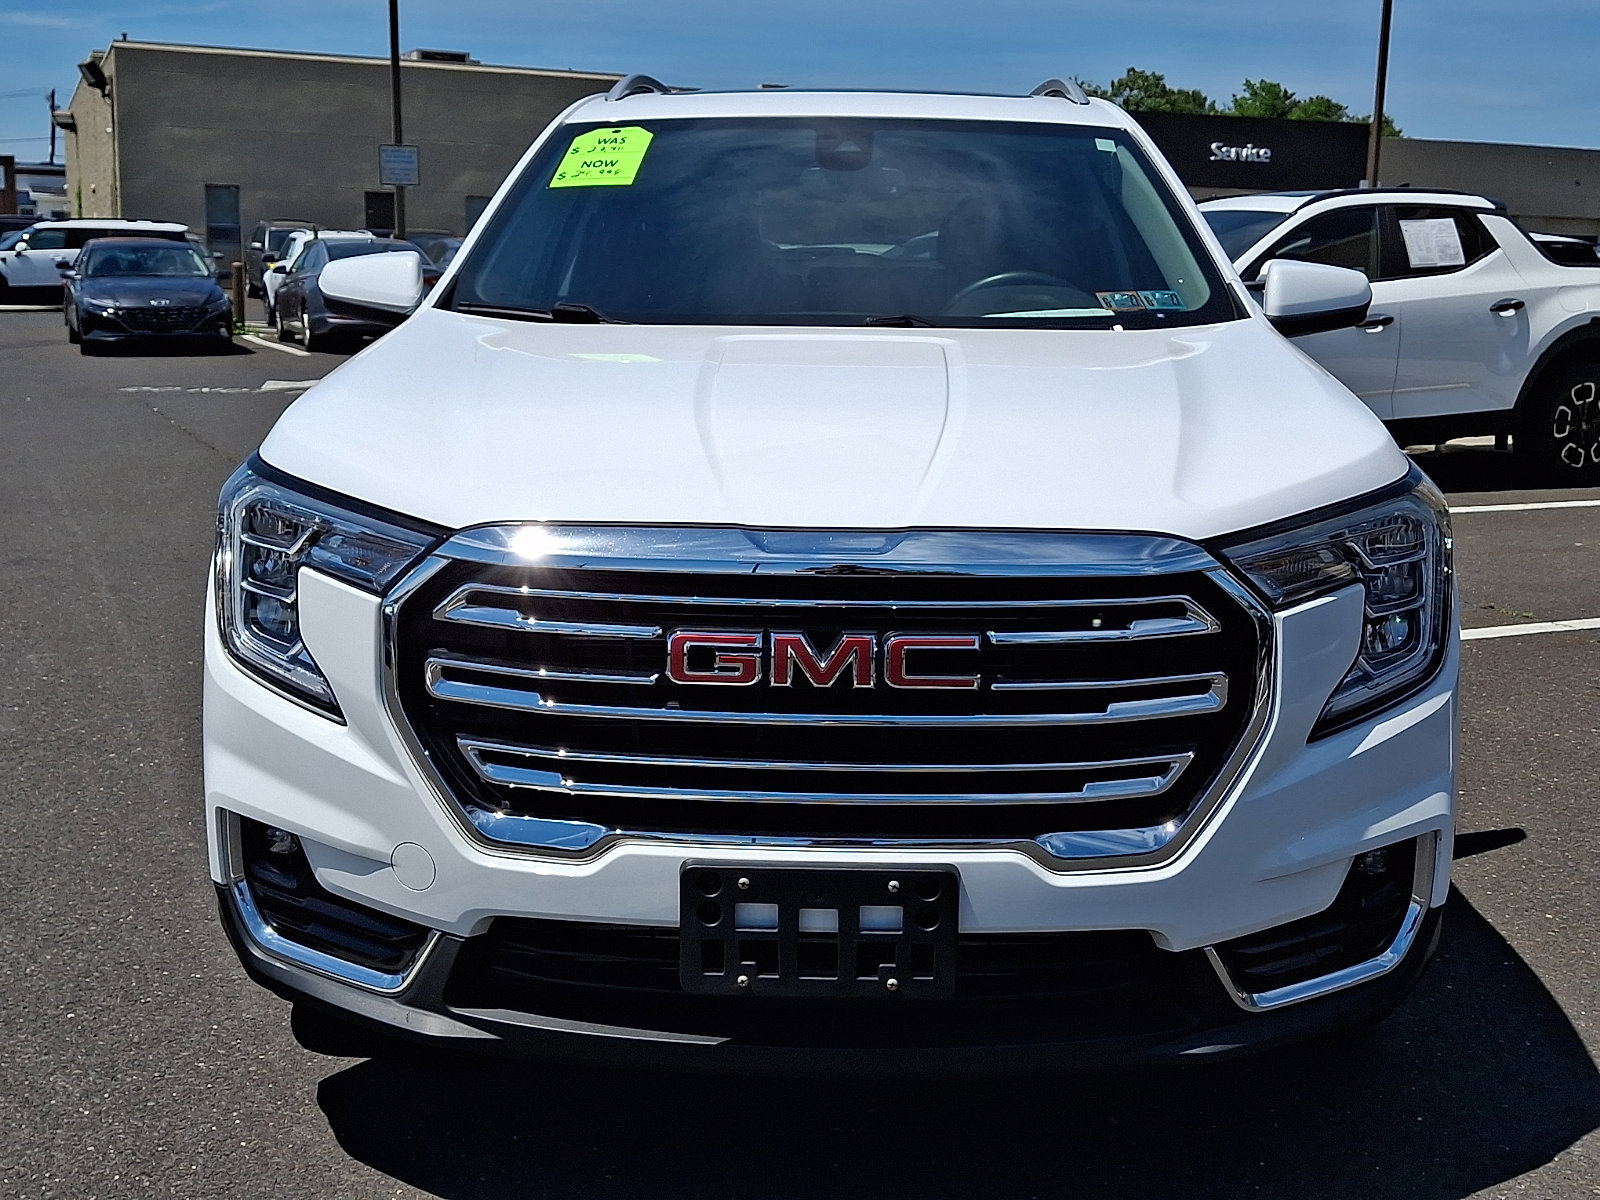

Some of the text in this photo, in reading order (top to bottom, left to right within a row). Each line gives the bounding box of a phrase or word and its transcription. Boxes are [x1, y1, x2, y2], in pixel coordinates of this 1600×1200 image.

[597, 137, 628, 145] WAS
[1209, 142, 1272, 162] Service
[580, 159, 619, 168] NOW
[666, 631, 981, 690] GMC
